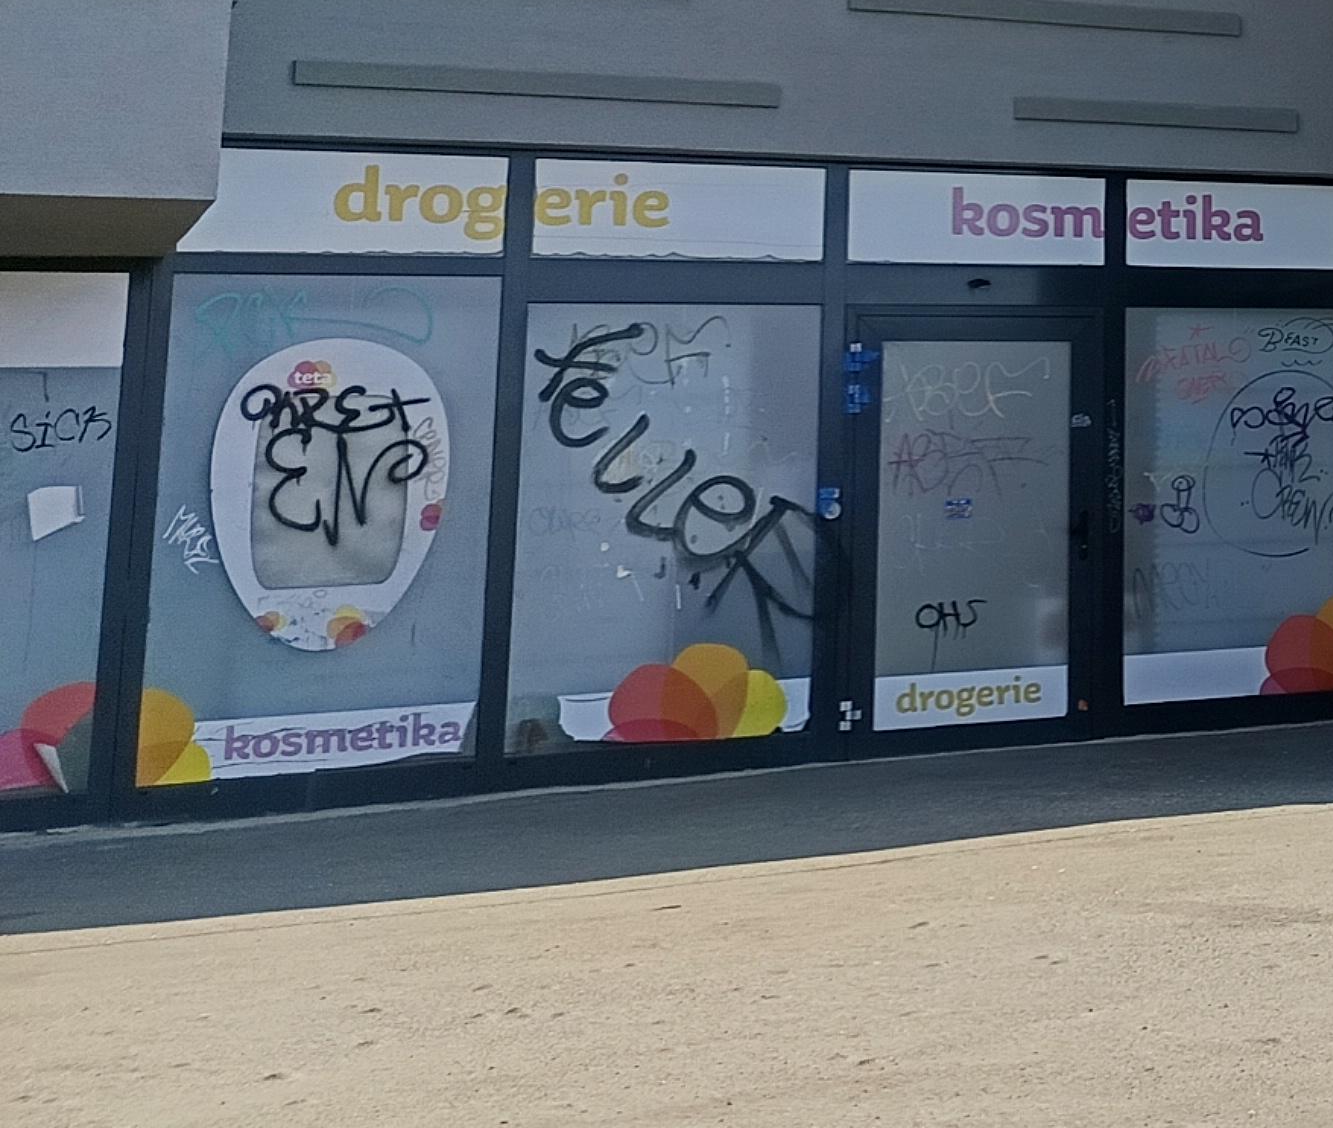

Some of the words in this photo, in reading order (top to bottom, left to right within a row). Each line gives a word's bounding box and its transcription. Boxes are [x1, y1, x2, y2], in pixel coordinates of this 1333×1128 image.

[333, 165, 671, 240] drogerie
[950, 187, 1264, 243] kosmetika
[294, 371, 333, 384] teta
[895, 675, 1042, 717] drogerie
[223, 715, 462, 763] kosmetika
